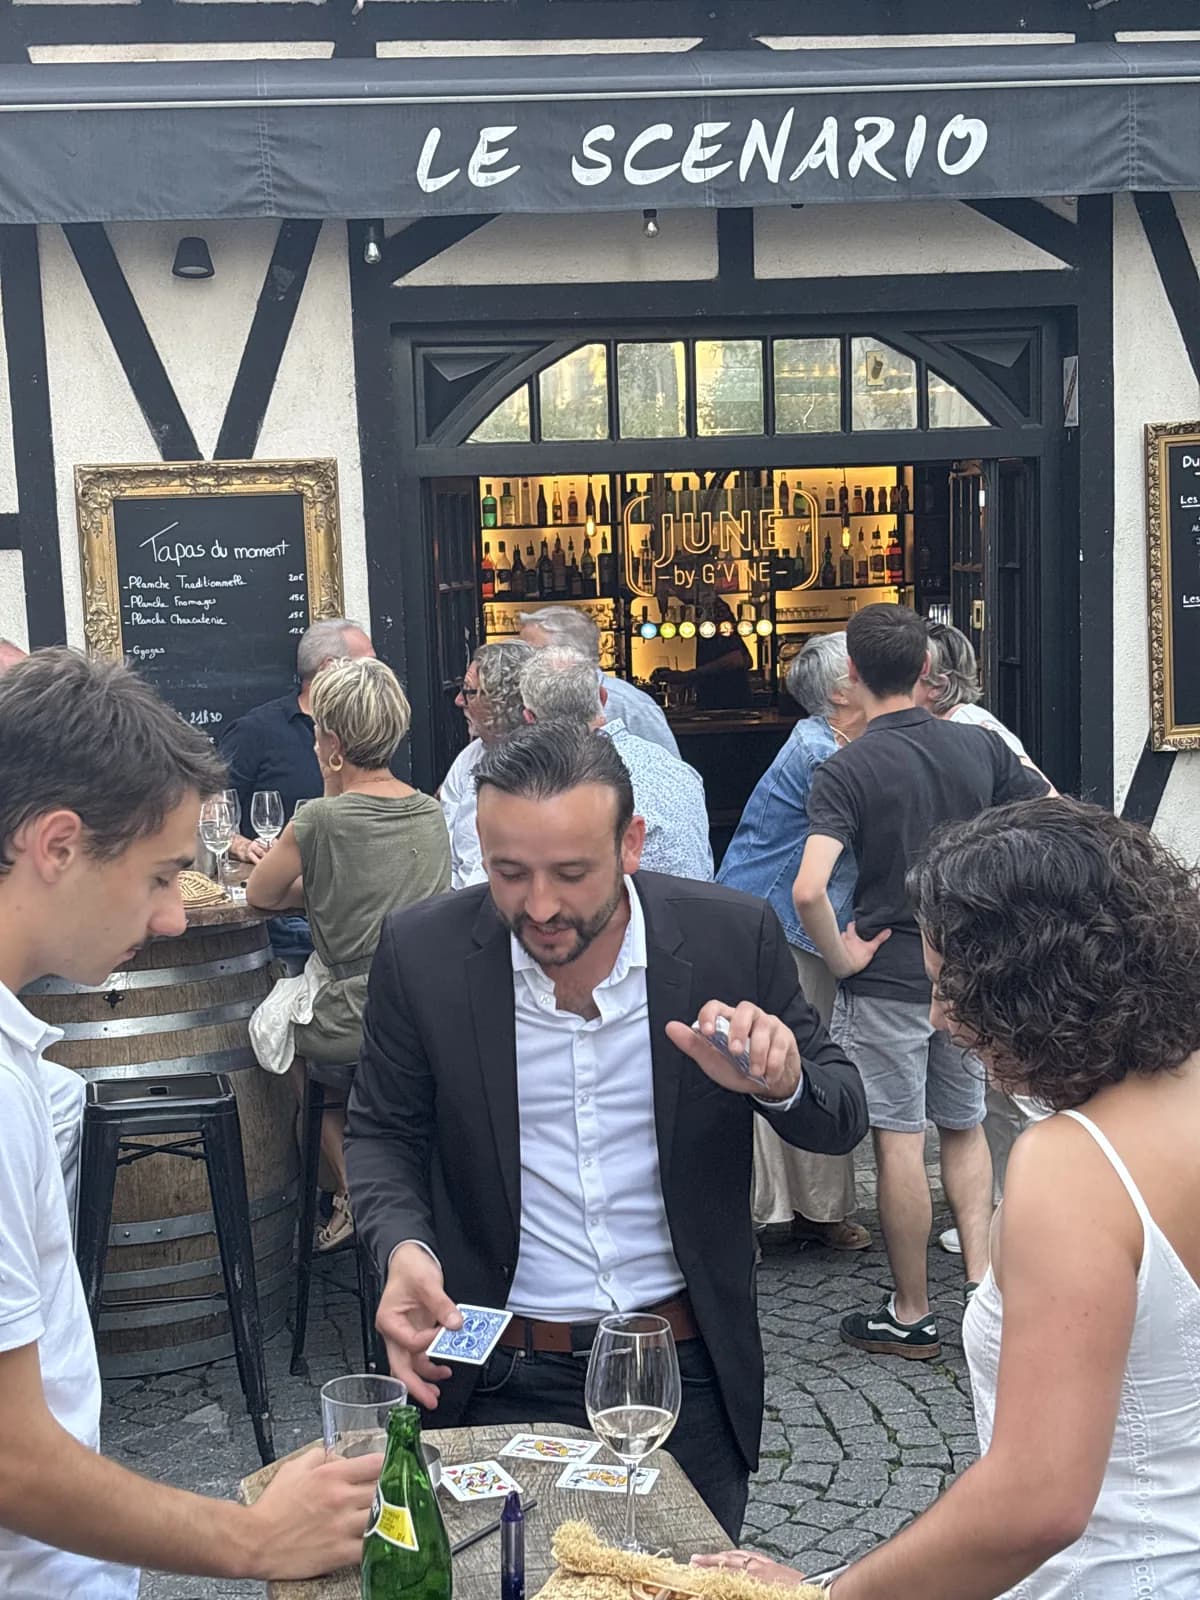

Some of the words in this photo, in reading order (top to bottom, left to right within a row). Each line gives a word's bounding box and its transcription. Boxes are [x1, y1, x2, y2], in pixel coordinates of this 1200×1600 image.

[416, 125, 521, 193] LE
[571, 107, 988, 186] SCENARIO
[139, 521, 206, 567] Tapas
[211, 539, 228, 559] du
[234, 539, 291, 560] moment
[654, 509, 784, 568] JUNE
